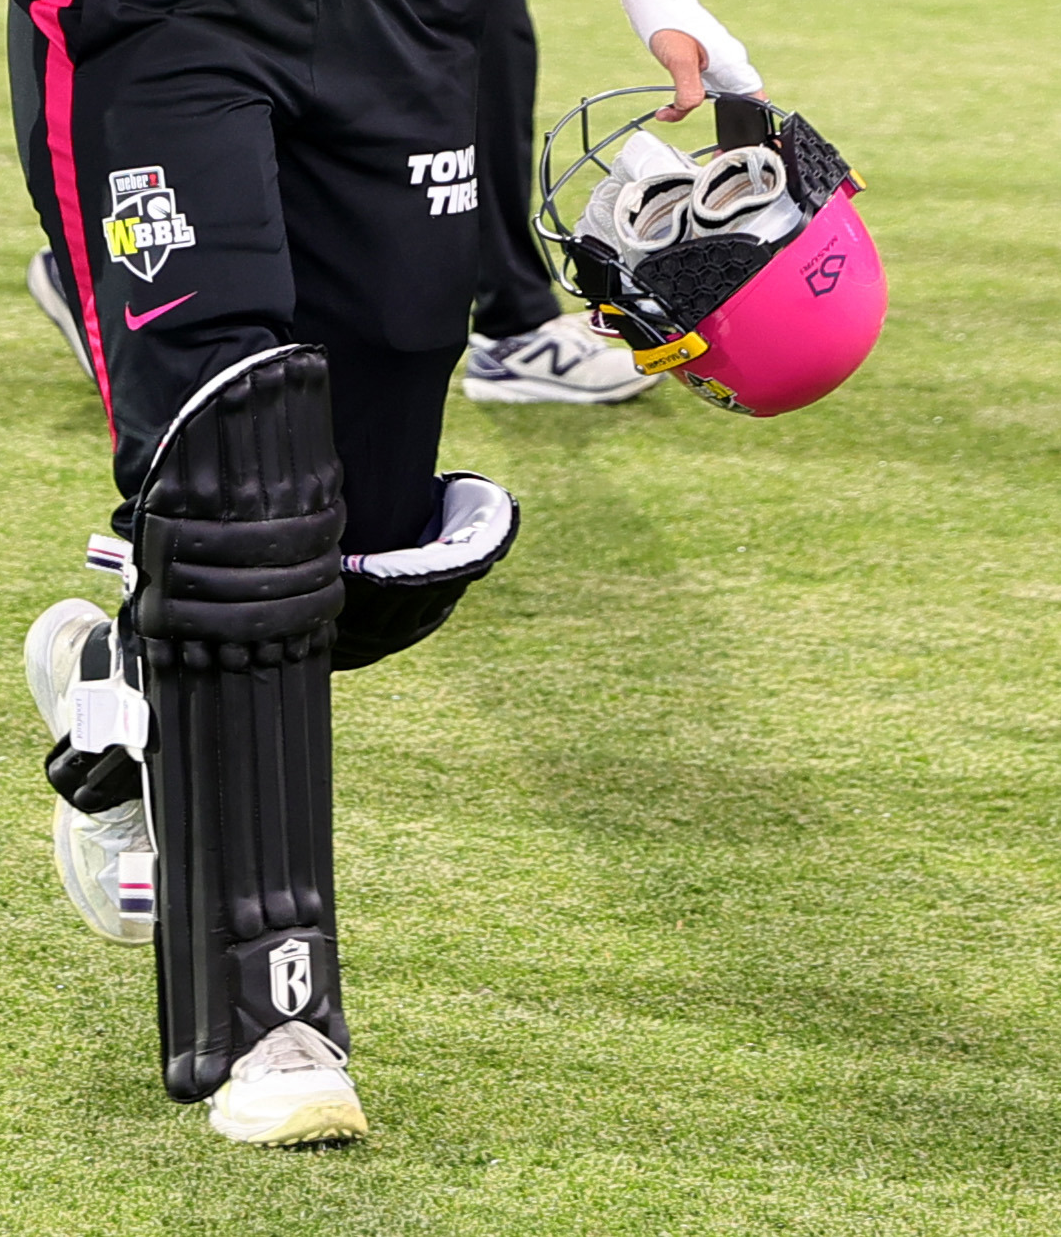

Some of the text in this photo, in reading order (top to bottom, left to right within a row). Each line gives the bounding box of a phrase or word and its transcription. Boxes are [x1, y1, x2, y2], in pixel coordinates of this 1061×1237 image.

[116, 173, 150, 192] weber
[427, 177, 478, 216] TIRE
[106, 216, 192, 256] WBBL
